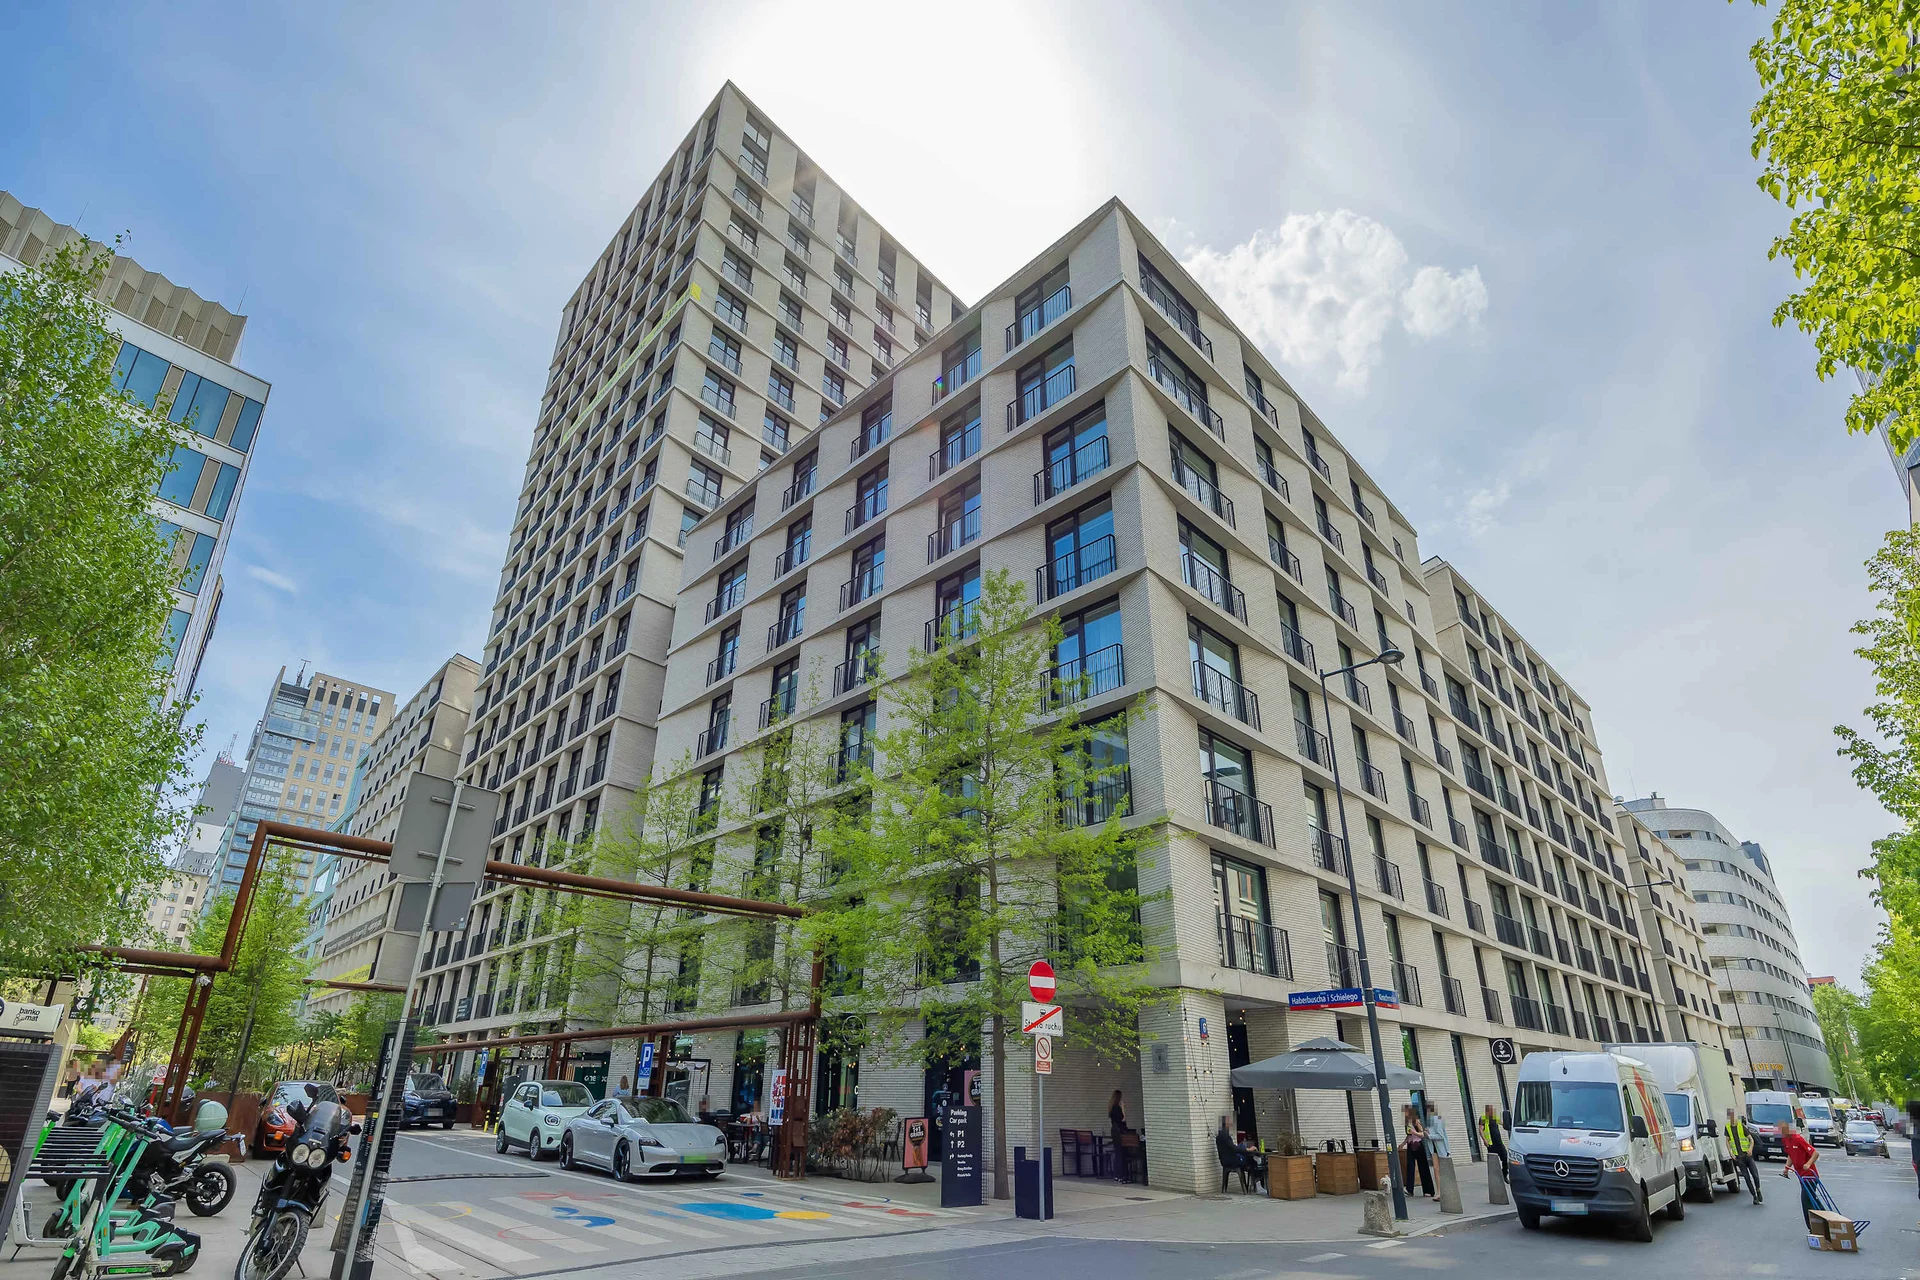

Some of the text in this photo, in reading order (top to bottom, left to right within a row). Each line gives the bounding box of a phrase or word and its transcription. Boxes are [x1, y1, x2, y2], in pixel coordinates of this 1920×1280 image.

[1291, 995, 1326, 1005] Haberbuscha
[1330, 993, 1358, 1003] Schielego
[19, 1007, 40, 1016] banko
[1045, 1022, 1061, 1031] ruchu
[642, 1046, 652, 1068] P
[951, 1109, 967, 1117] Parking
[957, 1117, 967, 1125] park
[957, 1140, 965, 1148] P2
